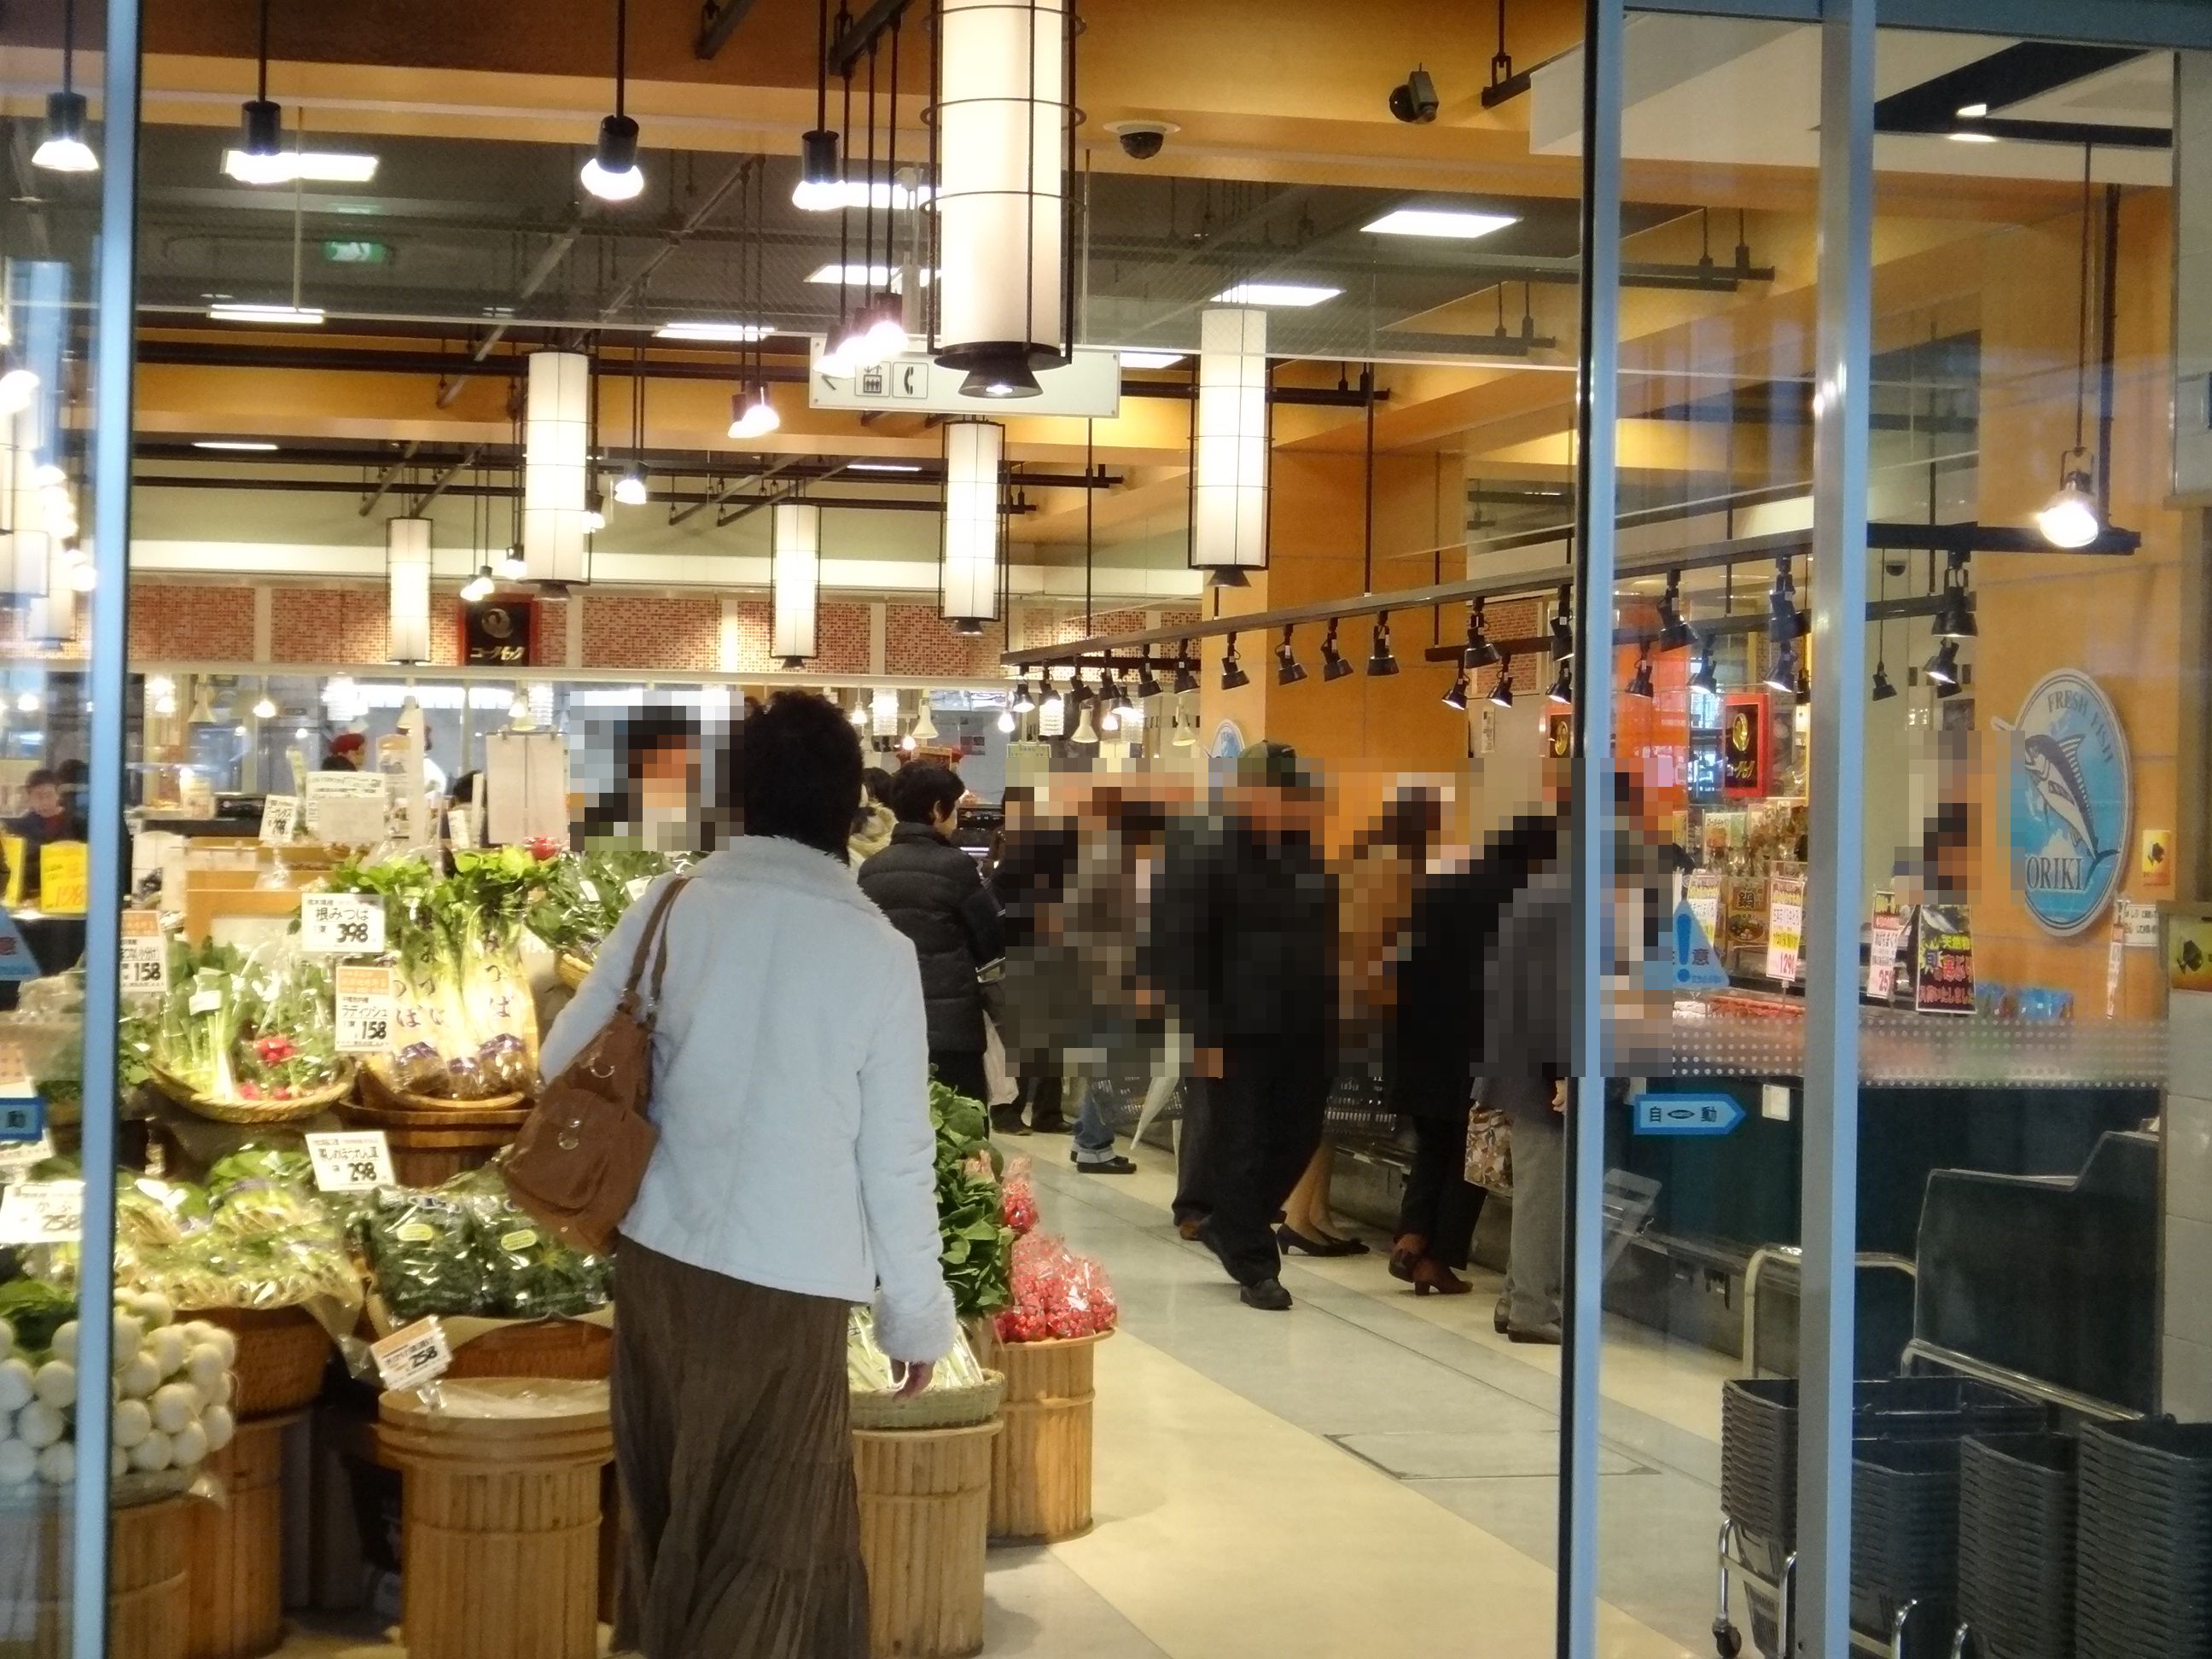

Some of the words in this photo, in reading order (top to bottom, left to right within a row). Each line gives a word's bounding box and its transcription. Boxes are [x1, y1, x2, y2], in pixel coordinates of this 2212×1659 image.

[2048, 690, 2089, 717] FRESH
[2090, 712, 2114, 763] FISH
[2025, 857, 2083, 890] ORIKI
[336, 923, 369, 943] 398
[134, 962, 161, 981] 158
[361, 1021, 387, 1039] 158
[347, 1161, 377, 1182] 298
[409, 1346, 438, 1369] 258
